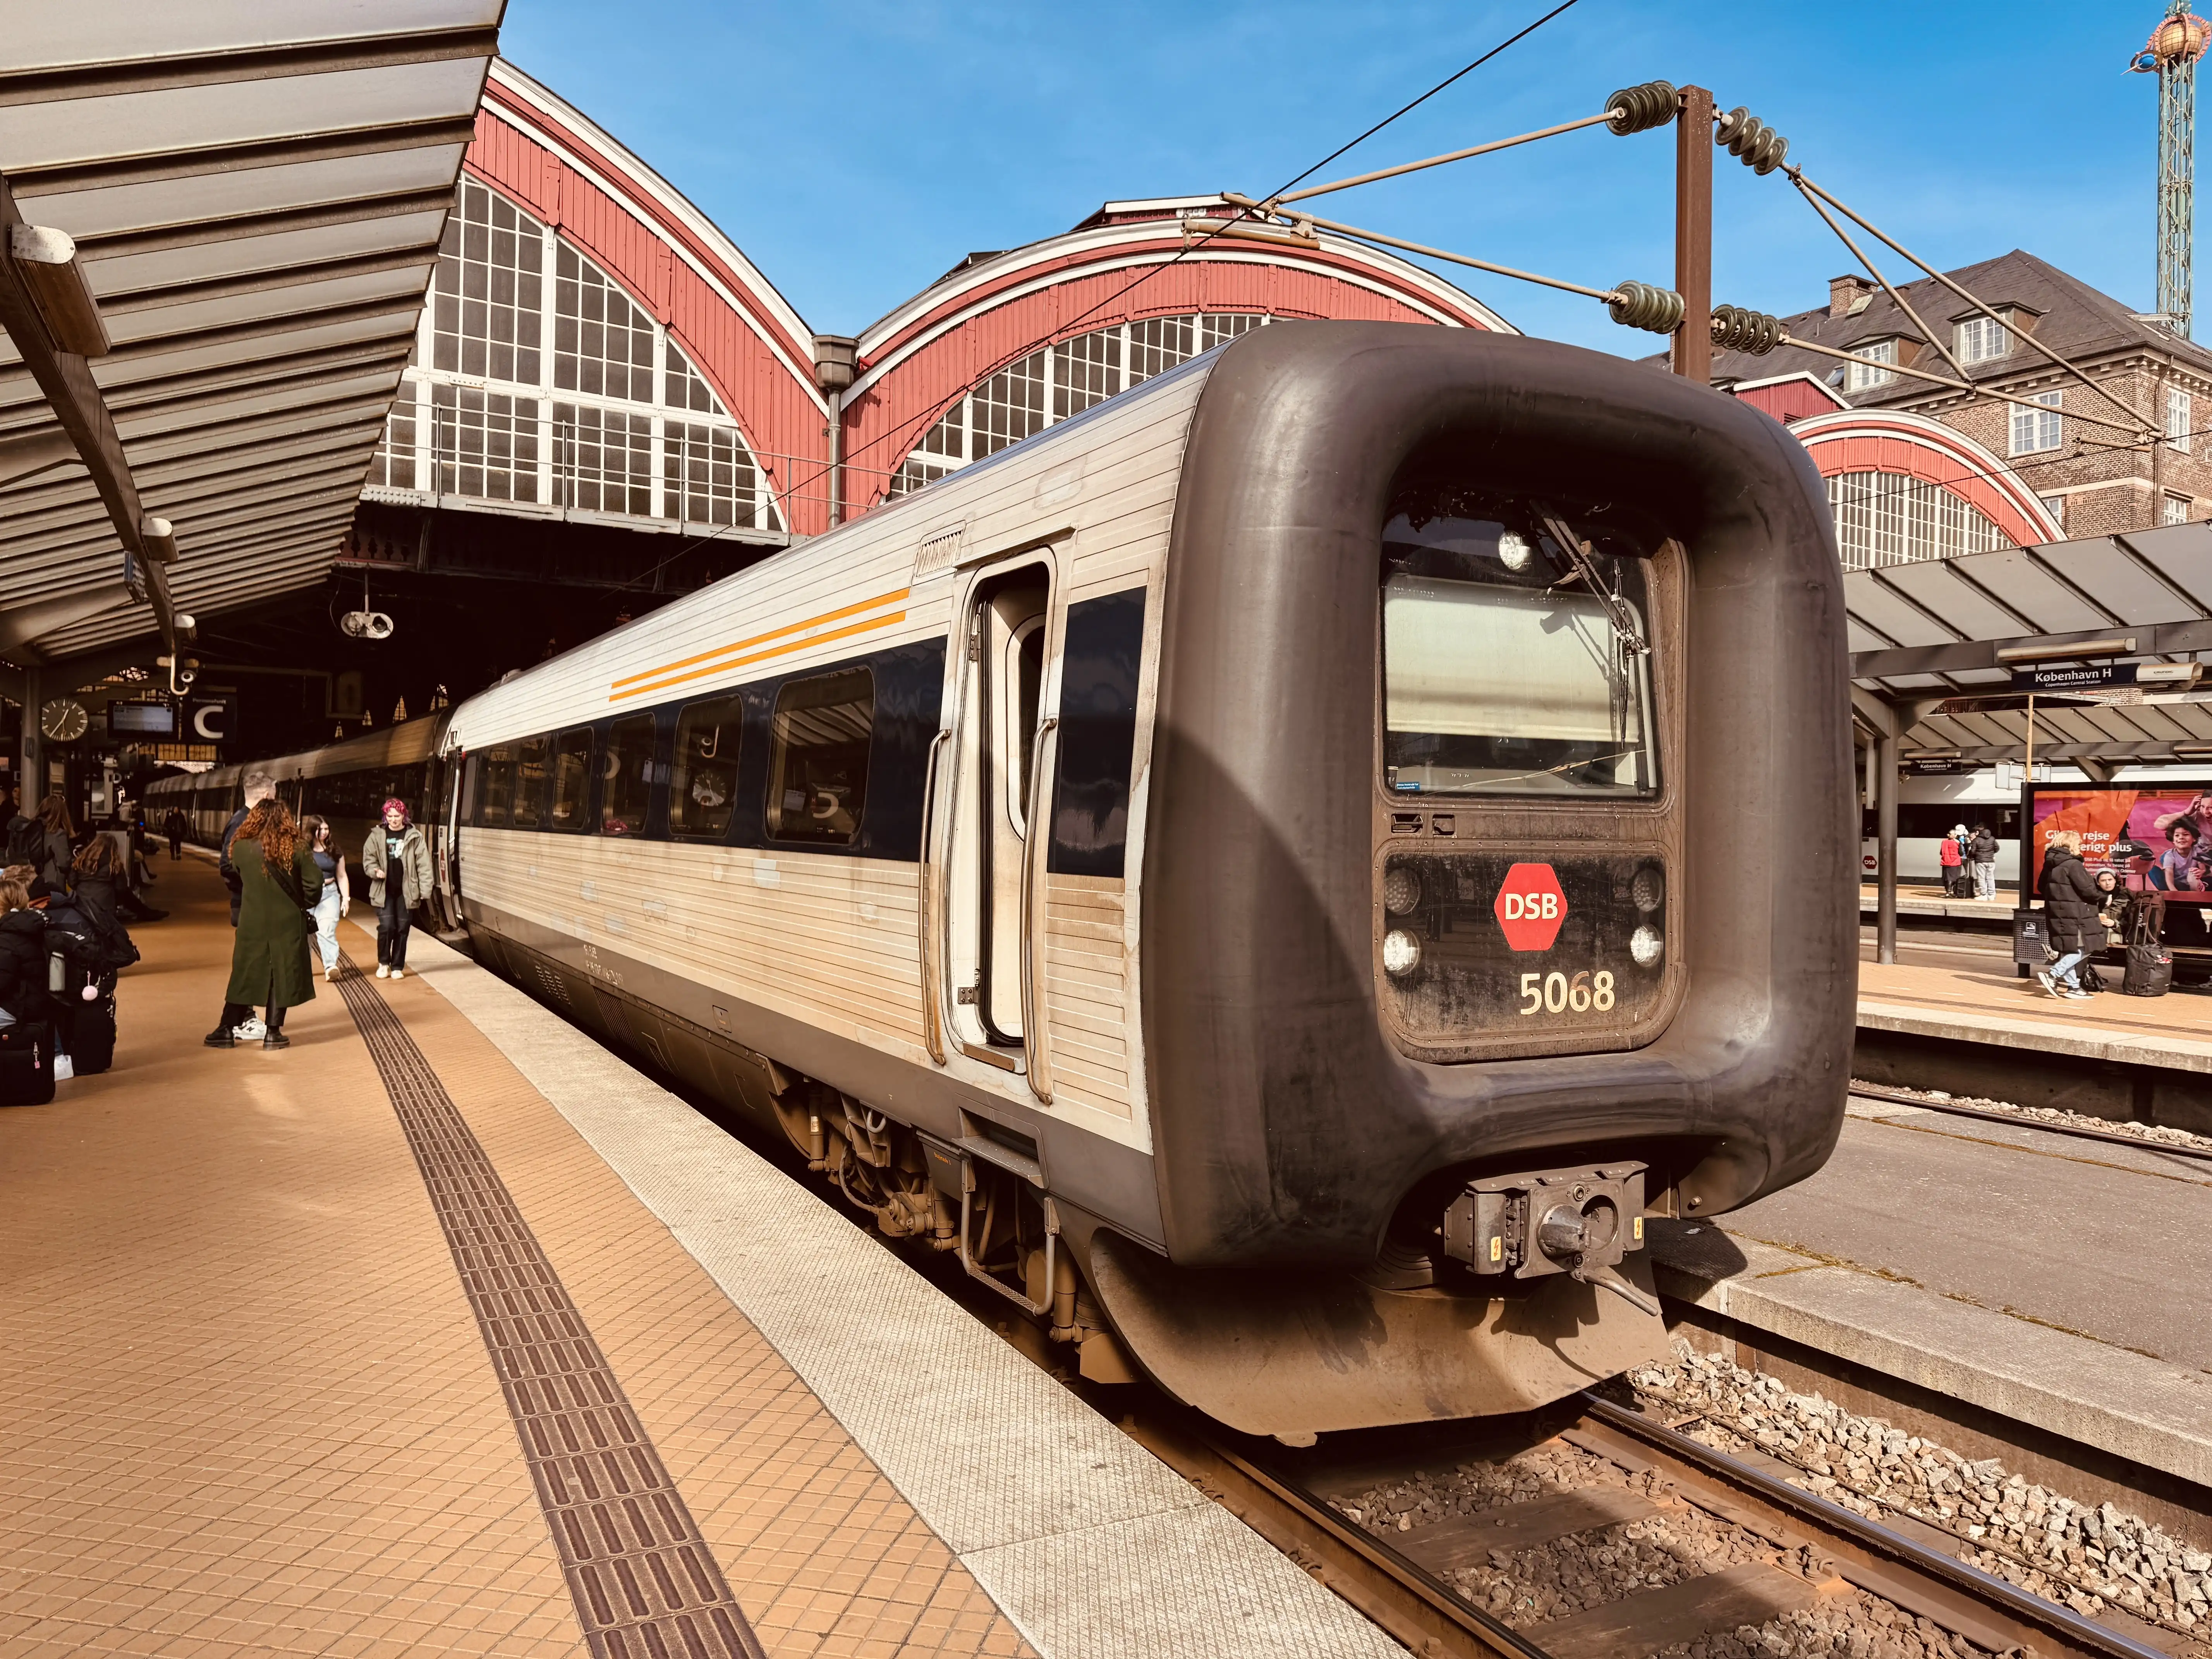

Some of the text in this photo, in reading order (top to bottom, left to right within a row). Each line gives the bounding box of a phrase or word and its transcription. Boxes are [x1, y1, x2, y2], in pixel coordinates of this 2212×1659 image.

[2035, 668, 2111, 682] København H
[194, 705, 223, 739] C
[2083, 831, 2110, 842] rejse
[2109, 842, 2132, 854] plus
[1505, 893, 1558, 920] DSB
[1520, 970, 1615, 1015] 5068
